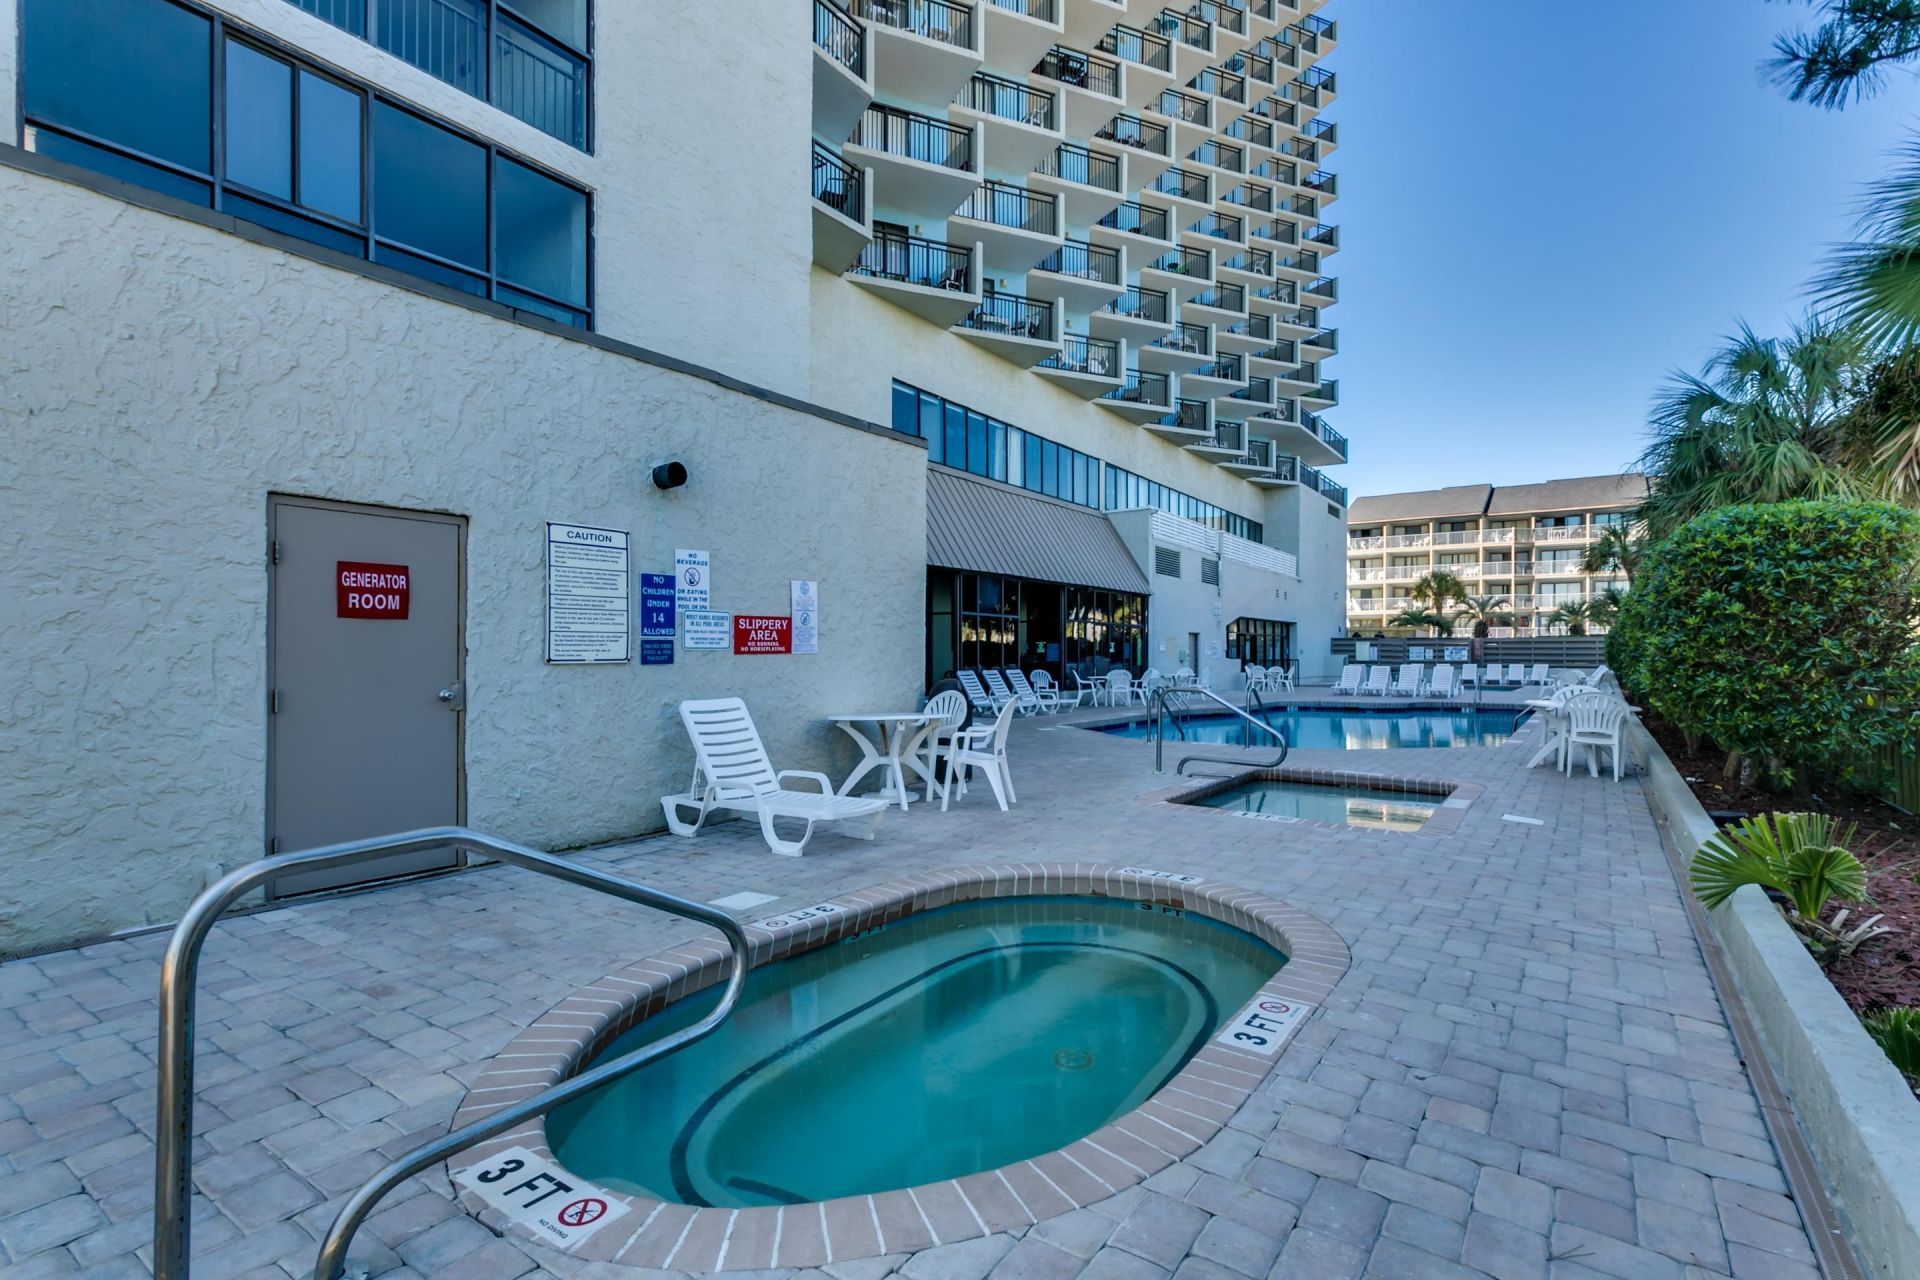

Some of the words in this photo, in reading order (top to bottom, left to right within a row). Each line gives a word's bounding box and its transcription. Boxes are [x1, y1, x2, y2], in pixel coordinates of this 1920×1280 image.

[566, 530, 612, 543] CAUTION
[341, 571, 407, 589] GENERATOR
[652, 575, 665, 584] NO
[642, 586, 674, 596] CHILDREN
[348, 593, 400, 610] ROOM
[647, 599, 670, 608] UNDER
[652, 612, 664, 623] 14
[738, 618, 788, 630] SLIPPERY
[642, 627, 674, 635] ALLOWED
[749, 630, 778, 640] AREA
[788, 911, 816, 920] FT
[1141, 903, 1152, 911] 3
[1162, 907, 1182, 917] FT
[1244, 1013, 1284, 1033] FT
[1233, 1032, 1268, 1046] 3
[477, 1159, 525, 1183] 3
[502, 1172, 574, 1209] FT
[538, 1218, 549, 1227] NO
[549, 1225, 569, 1240] DIVING
